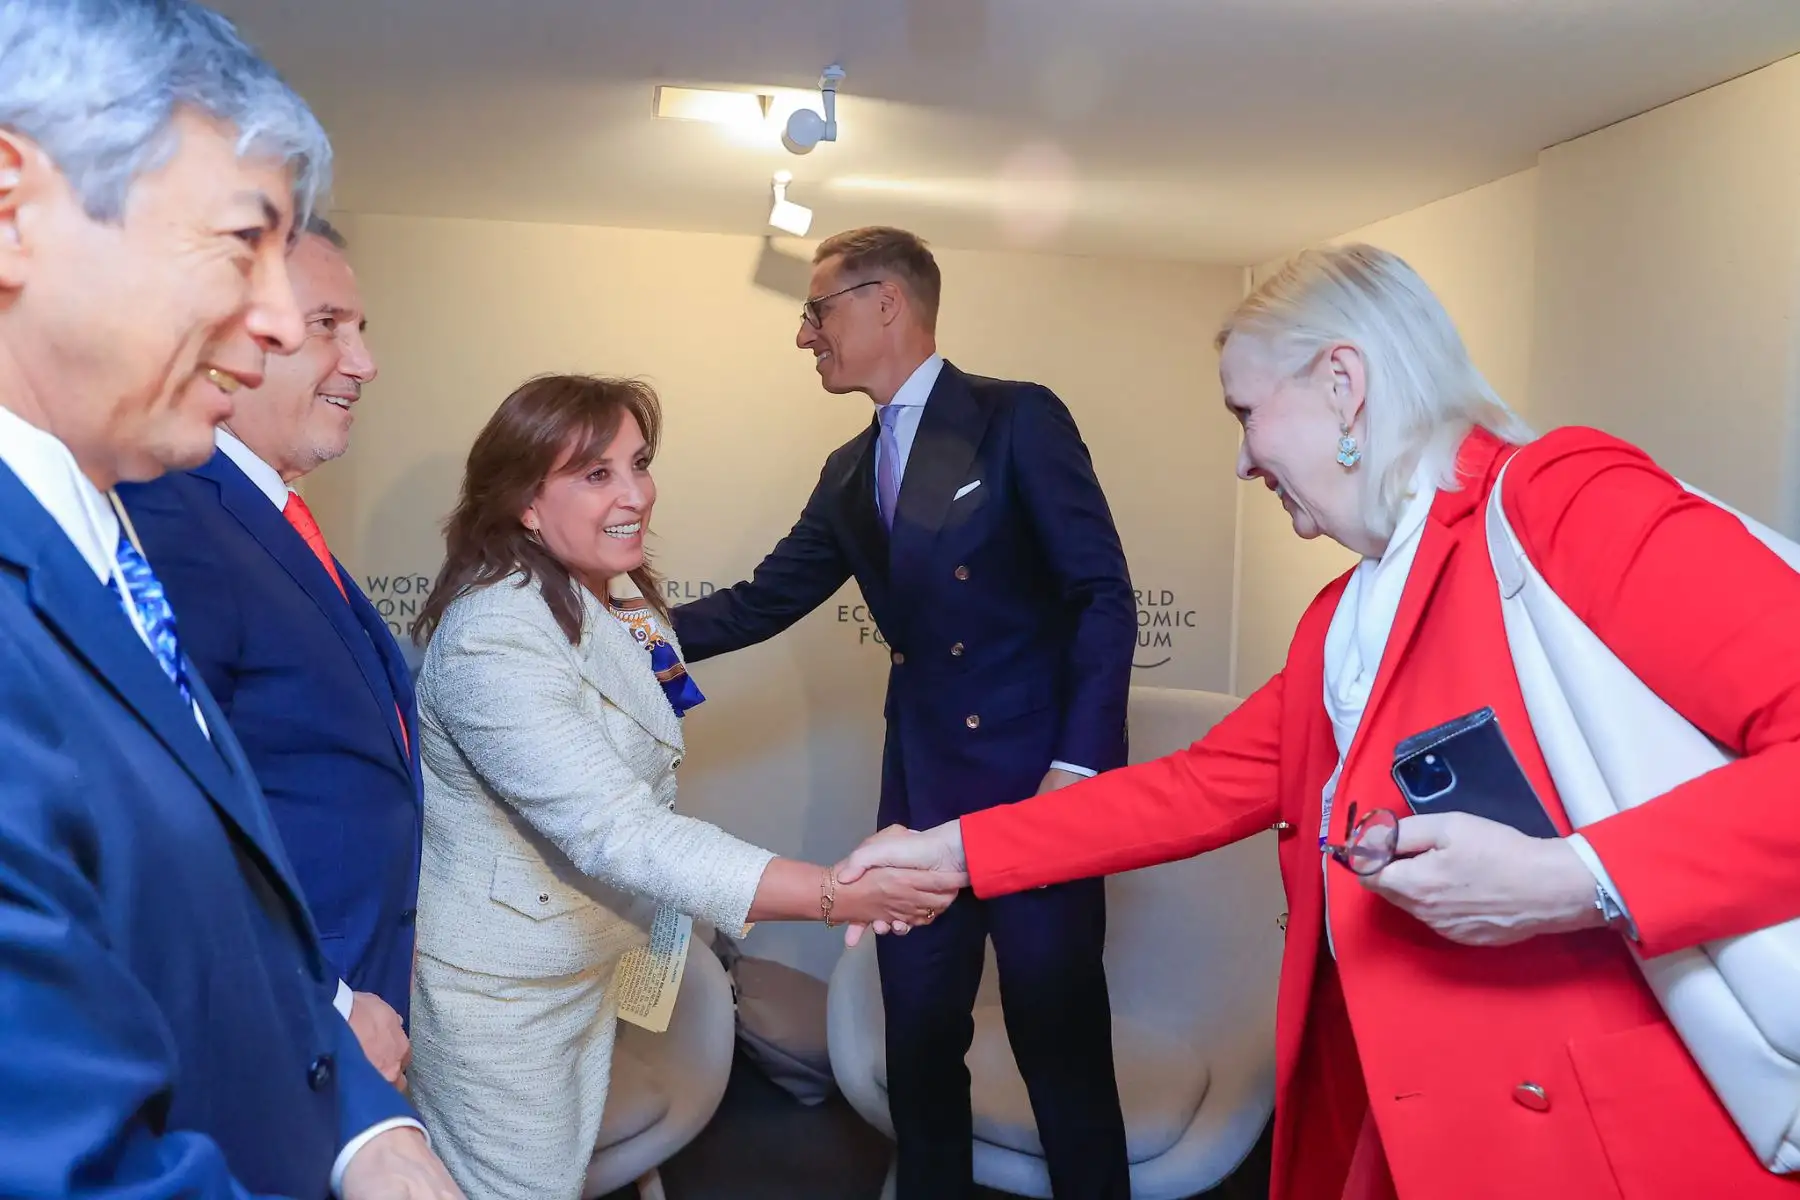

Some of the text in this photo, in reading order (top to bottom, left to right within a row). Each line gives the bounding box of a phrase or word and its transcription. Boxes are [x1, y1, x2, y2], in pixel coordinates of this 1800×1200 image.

[367, 576, 429, 594] WOR
[667, 581, 715, 598] RLD
[1134, 590, 1174, 606] RLD
[1137, 610, 1196, 628] OMIC
